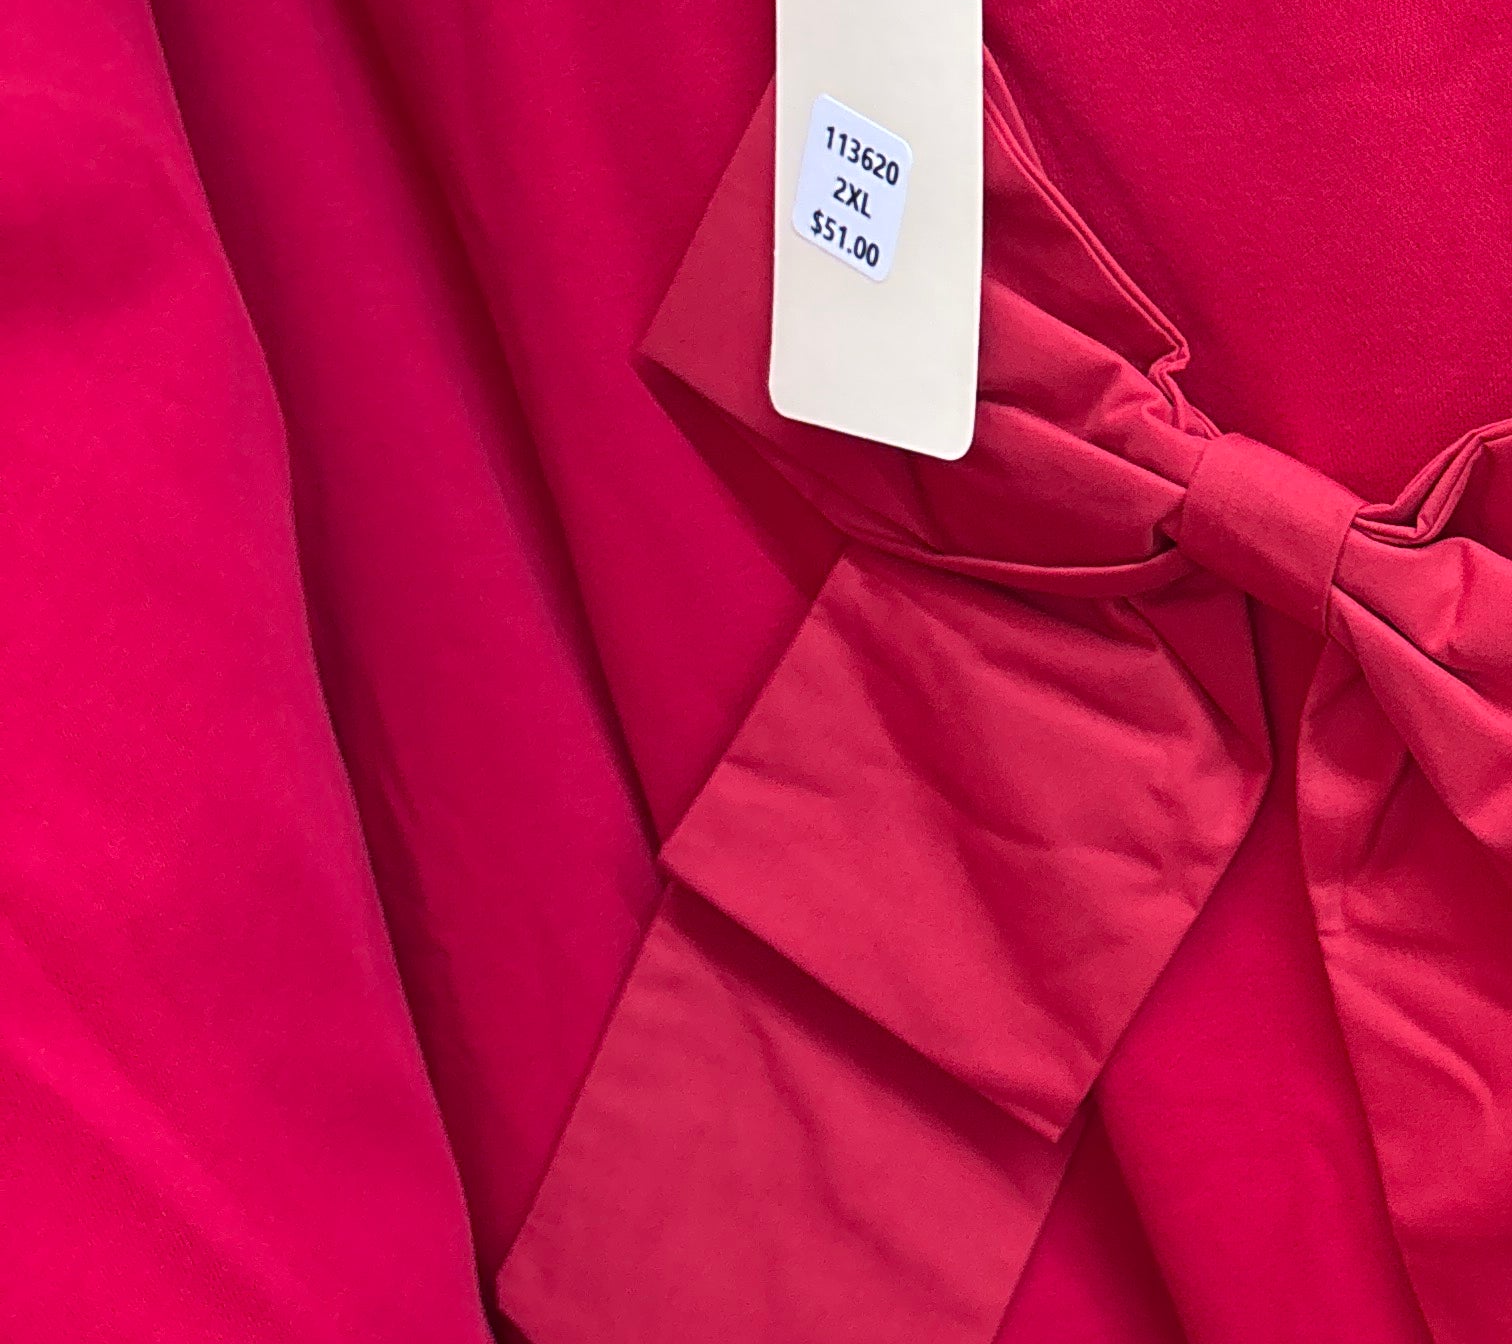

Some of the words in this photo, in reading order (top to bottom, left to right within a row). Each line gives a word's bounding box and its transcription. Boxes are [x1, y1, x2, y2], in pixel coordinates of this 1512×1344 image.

[826, 126, 899, 185] 113620
[833, 176, 872, 219] 2XL
[811, 209, 880, 267] $51.00
